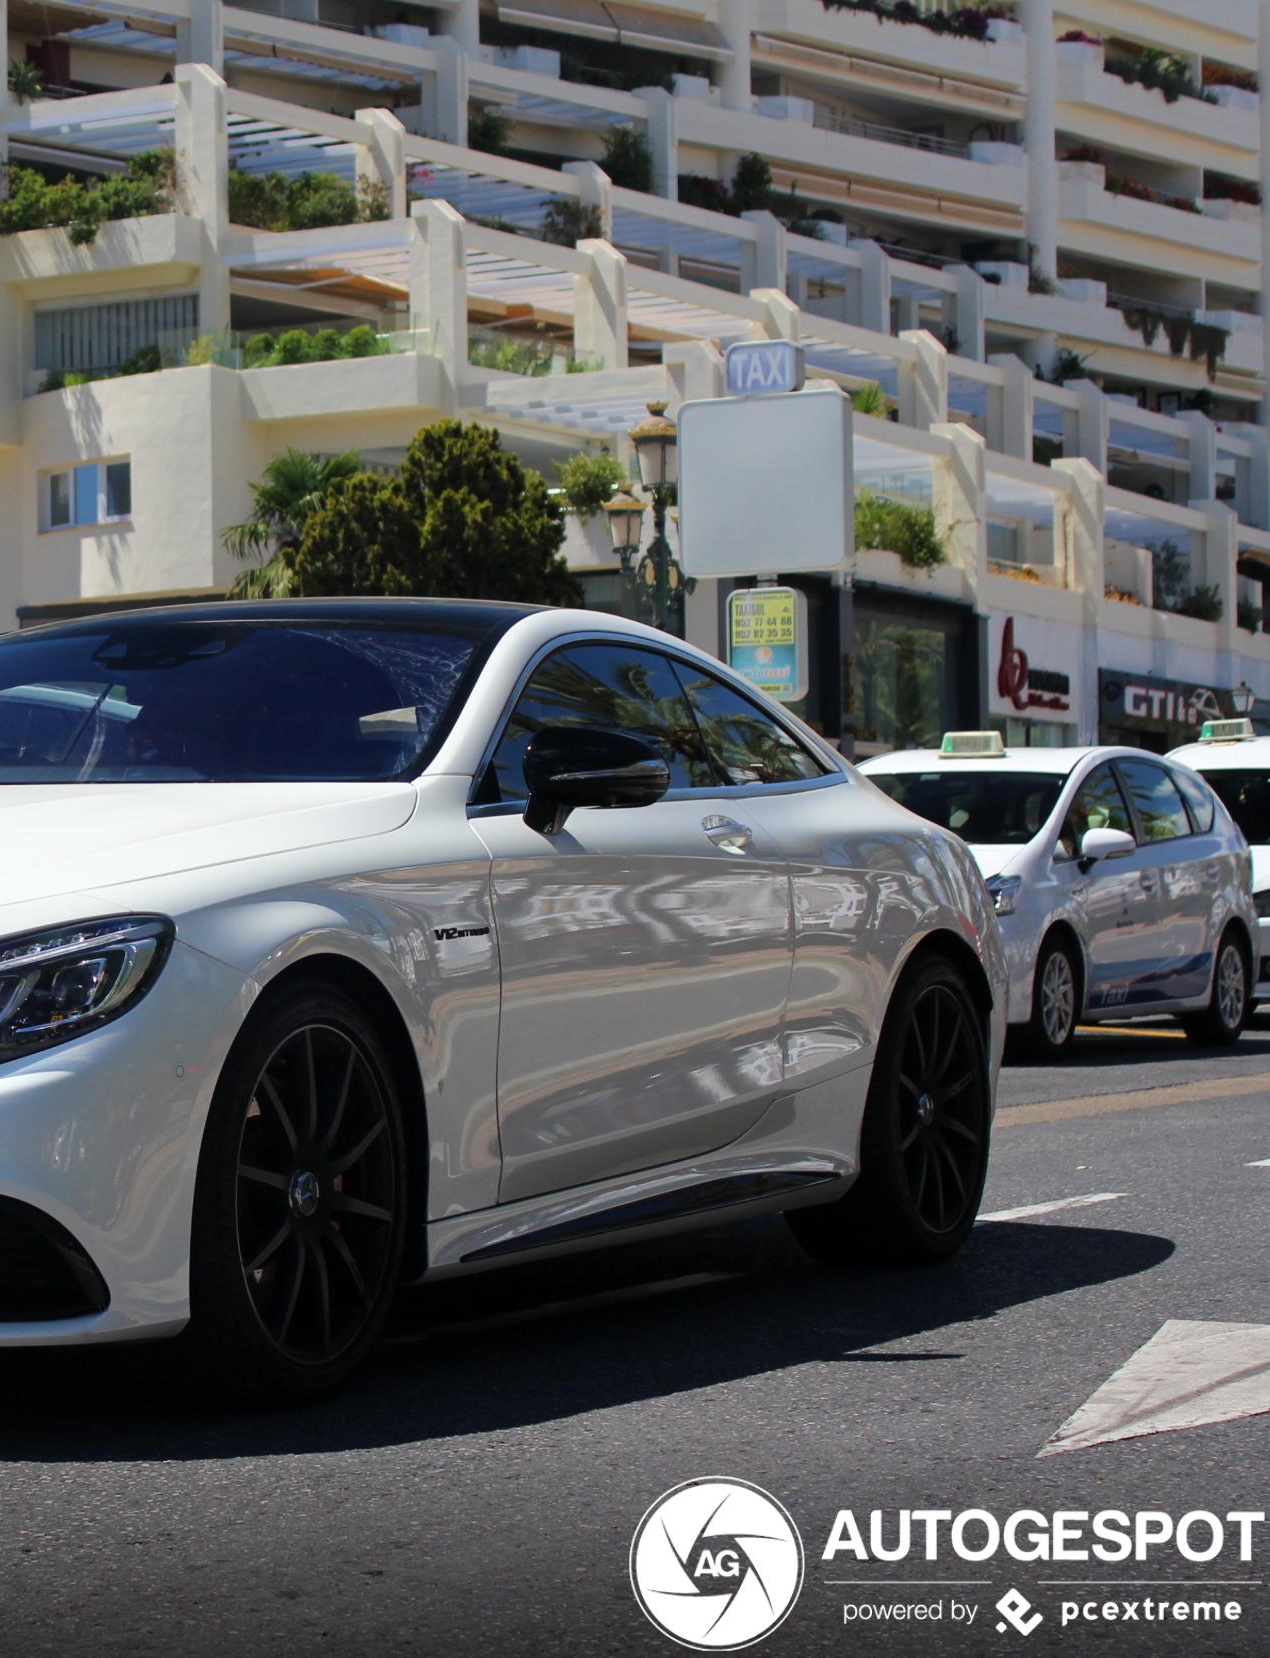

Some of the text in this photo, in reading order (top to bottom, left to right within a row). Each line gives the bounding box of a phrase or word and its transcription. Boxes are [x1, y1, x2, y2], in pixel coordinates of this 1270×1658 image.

[731, 350, 791, 388] TAXI
[734, 603, 765, 616] TAXISOL
[735, 618, 751, 628] 952
[754, 618, 763, 627] 77
[767, 617, 777, 626] 44
[735, 629, 751, 639] 952
[767, 628, 778, 638] 35
[781, 627, 792, 637] 35
[1124, 685, 1174, 721] GTI
[434, 928, 458, 941] V12
[1101, 981, 1130, 1005] Taxi
